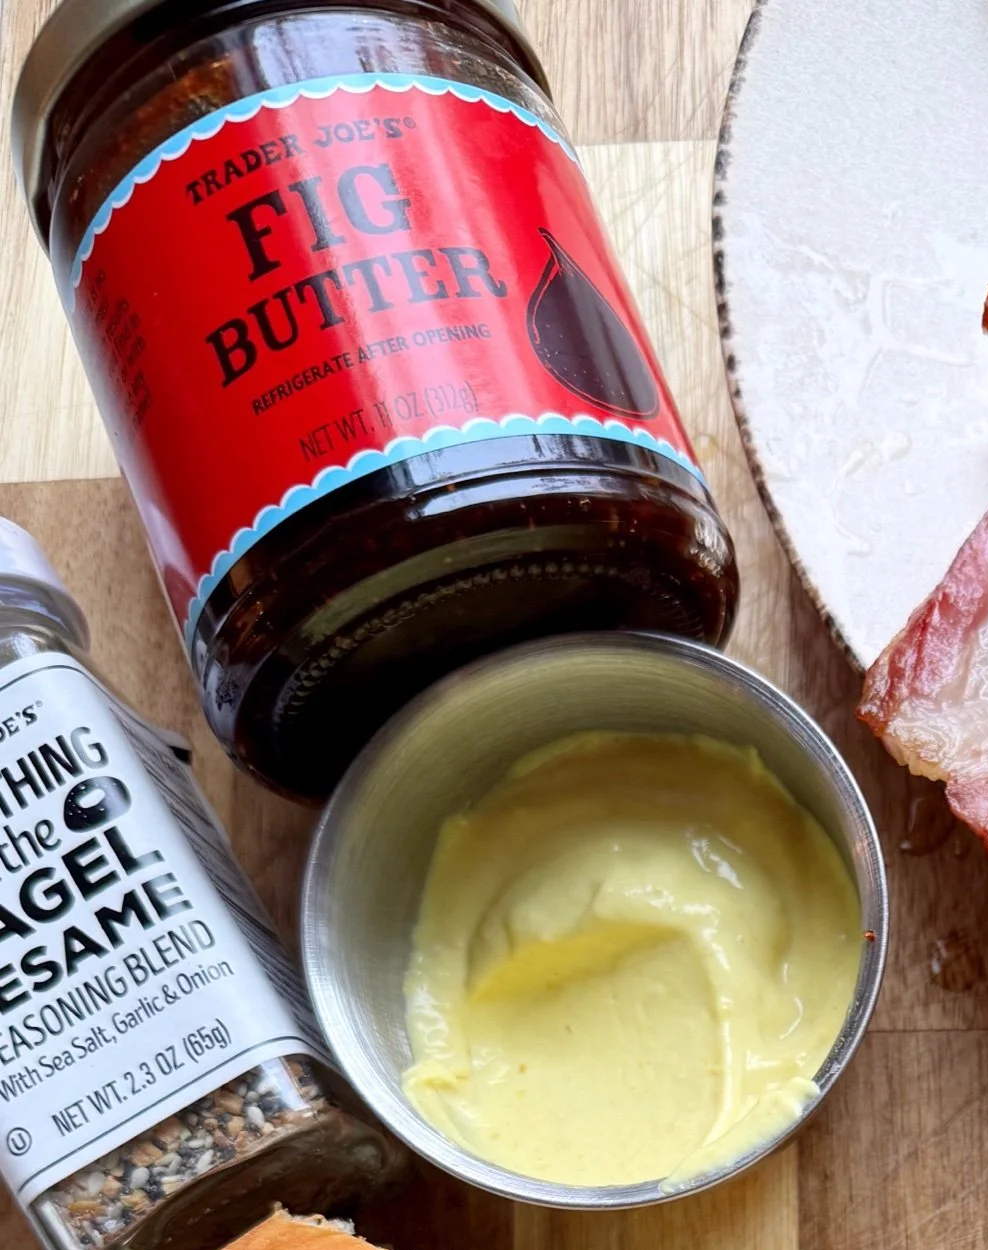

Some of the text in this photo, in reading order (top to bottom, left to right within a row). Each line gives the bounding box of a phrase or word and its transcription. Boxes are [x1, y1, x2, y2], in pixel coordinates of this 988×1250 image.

[185, 134, 304, 206] TRADER
[225, 162, 412, 283] FIG
[204, 246, 508, 389] BUTTER
[251, 323, 493, 416] REFRIGERATE AFTER OPENING
[298, 425, 335, 463] NET
[373, 401, 393, 428] 11
[394, 392, 424, 422] OZ
[424, 379, 479, 417] (312g)
[123, 919, 216, 987] BLEND
[0, 960, 235, 1102] With Sea Salt, Garlic & Onion
[51, 1017, 233, 1137] NET WT. 2.3 OZ (65g)
